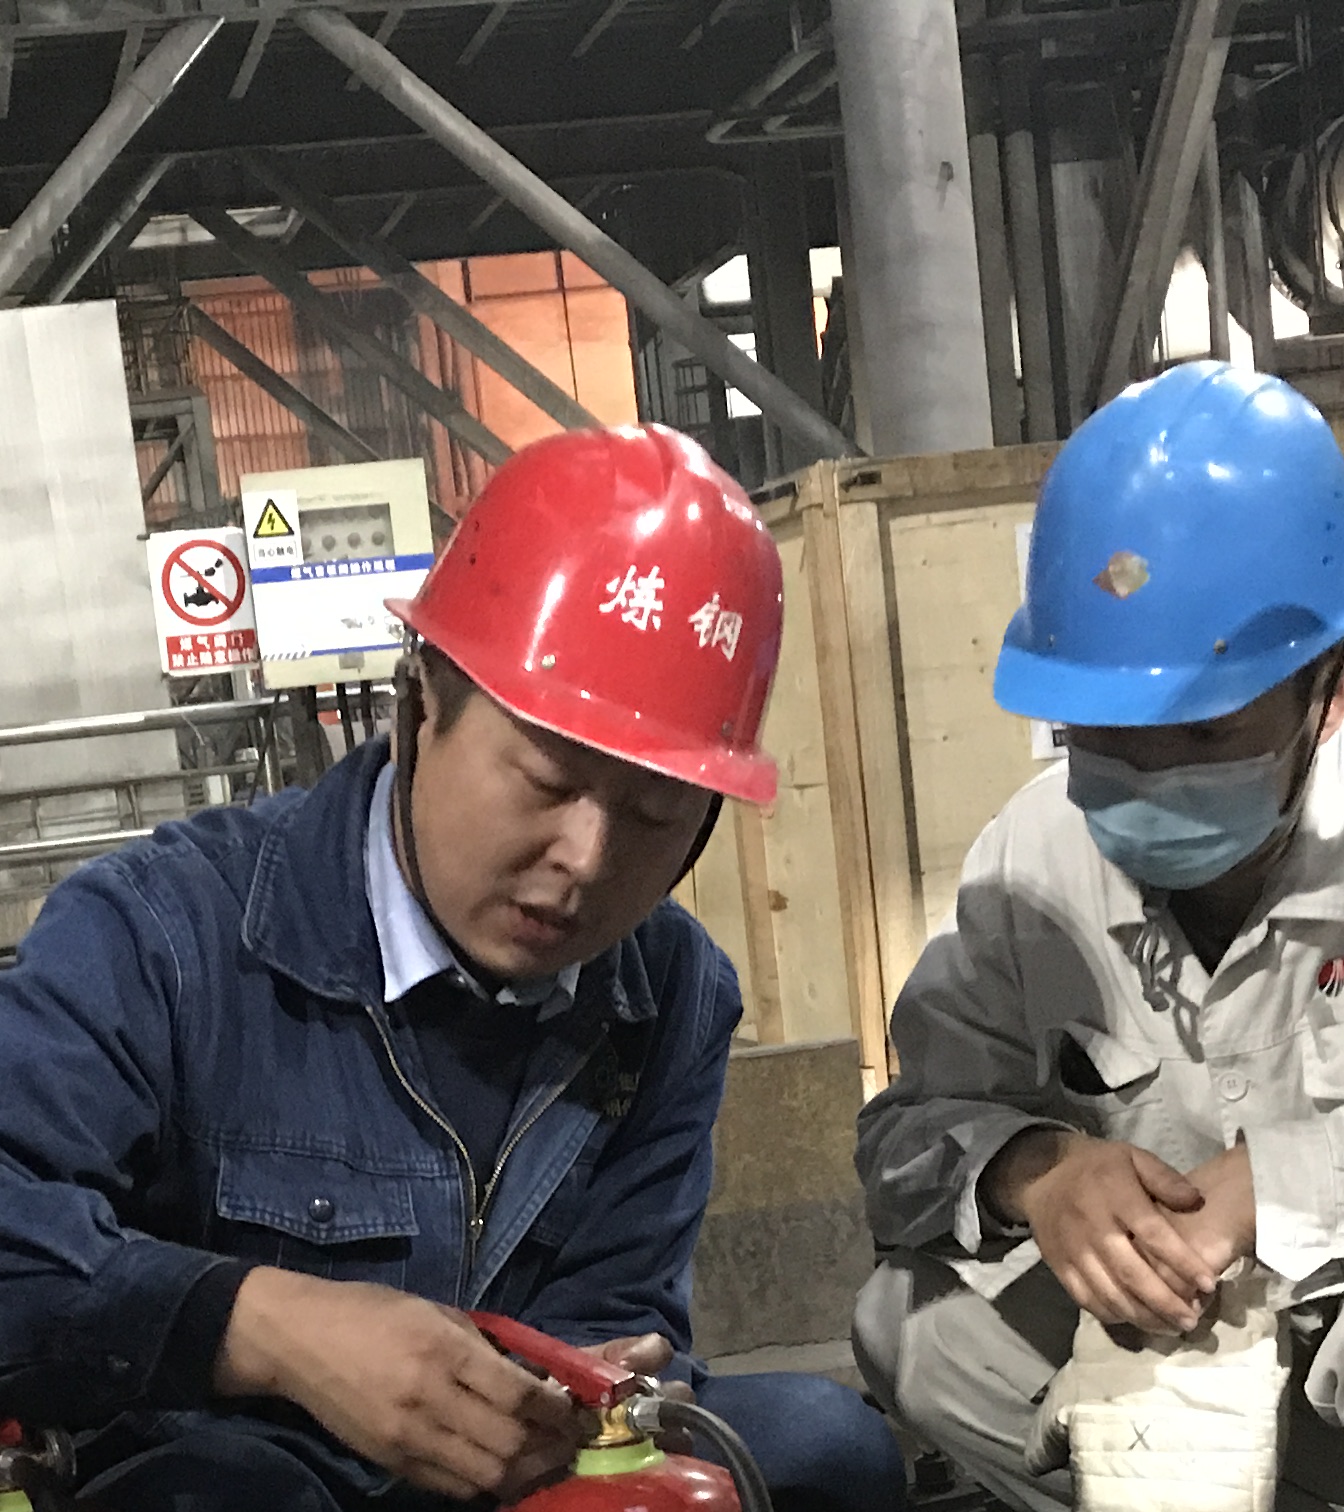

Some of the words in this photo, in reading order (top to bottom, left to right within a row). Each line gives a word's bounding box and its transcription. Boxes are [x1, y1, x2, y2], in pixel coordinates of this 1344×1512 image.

[599, 564, 744, 662] 炼钢
[179, 632, 244, 652] 煤气阀门
[171, 646, 254, 668] 禁止随意操作
